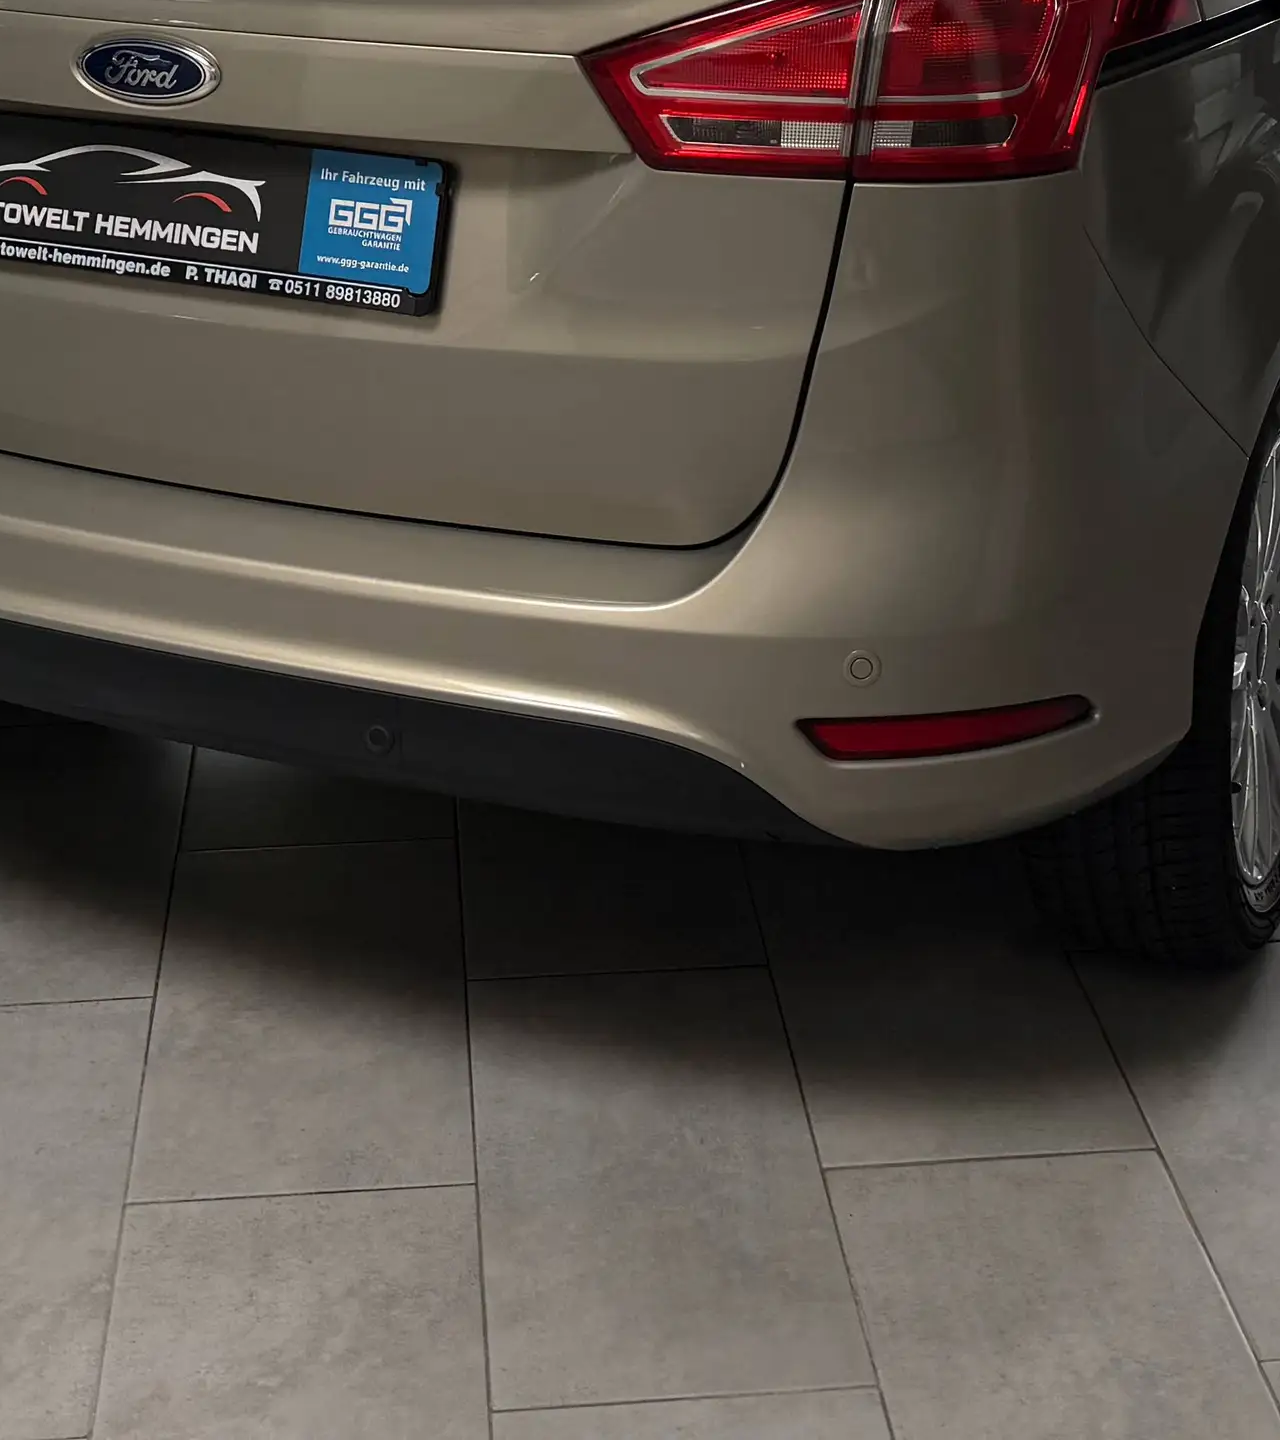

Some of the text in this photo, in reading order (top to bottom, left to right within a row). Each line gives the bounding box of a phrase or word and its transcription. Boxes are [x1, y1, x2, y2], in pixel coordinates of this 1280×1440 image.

[105, 50, 179, 89] Ford
[320, 168, 426, 192] Ihr Fahrzeug mit
[328, 198, 405, 234] GGG
[95, 213, 259, 254] HEMMINGEN
[327, 226, 402, 243] GEBRAUCHTWAGEN
[361, 239, 401, 251] GARANTIE
[316, 254, 410, 273] www.ggg-garantie.de
[185, 265, 199, 281] P.
[204, 268, 257, 289] THAQI
[284, 279, 320, 298] 0511
[325, 285, 401, 308] 89813880
